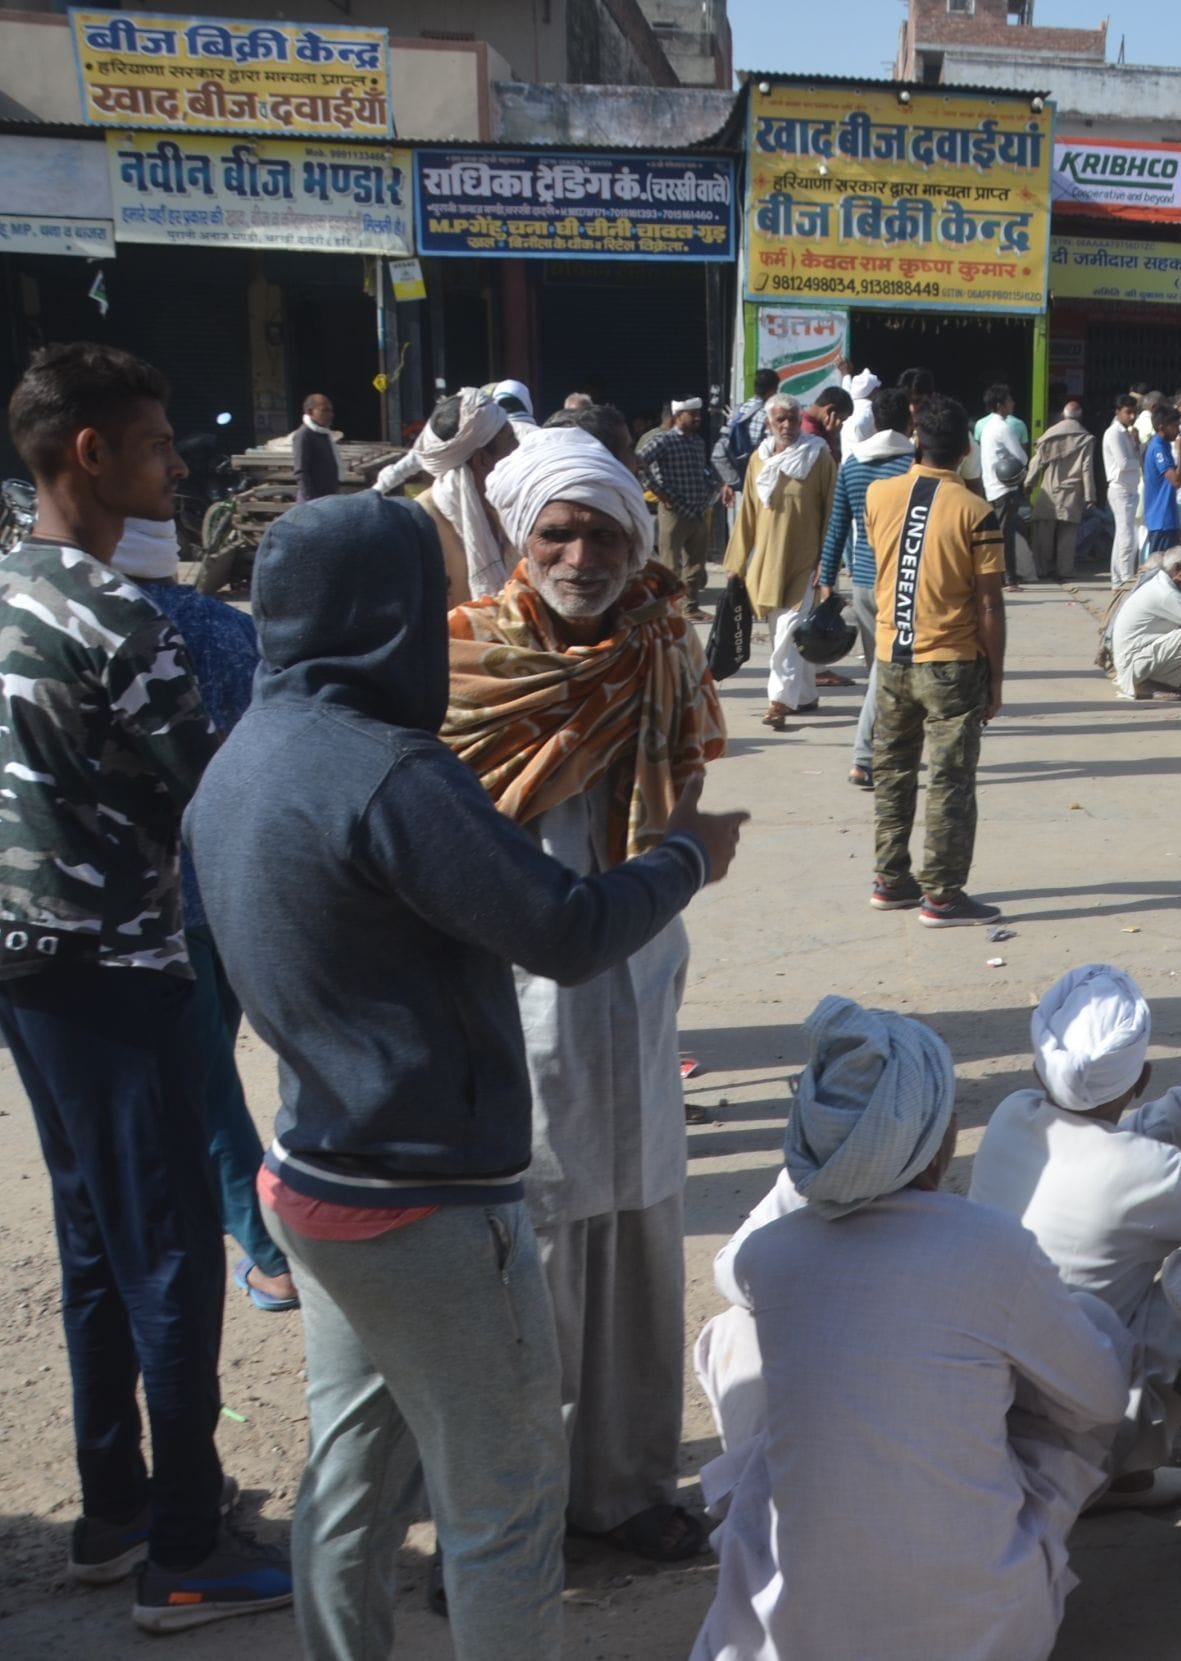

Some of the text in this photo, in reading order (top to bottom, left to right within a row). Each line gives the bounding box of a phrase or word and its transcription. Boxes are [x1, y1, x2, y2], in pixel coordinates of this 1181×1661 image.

[84, 19, 380, 69] बीज बिक्री केन्द्र
[97, 58, 164, 76] हरियाणा
[168, 65, 225, 79] सरकार
[229, 69, 260, 84] द्वारा
[187, 81, 257, 120] बीज
[756, 111, 1045, 169] खाद बीज दवाईयां
[118, 141, 402, 206] नवीन बीज भण्डार
[423, 162, 533, 198] राधिका
[535, 163, 613, 203] ट्रेडिंग
[772, 171, 1011, 201] हरियाणा सरकार द्वारा मान्यता प्राप्त
[1059, 151, 1179, 182] KRIBHCO
[1071, 187, 1175, 205] Cooperative and beyond
[756, 192, 834, 238] बीज
[839, 195, 936, 245] बिक्री
[800, 249, 859, 271] केवल
[859, 255, 894, 272] राम
[898, 257, 954, 279] कृष्ण
[957, 261, 1018, 282] कुमार
[897, 506, 928, 646] UNDEFEATED
